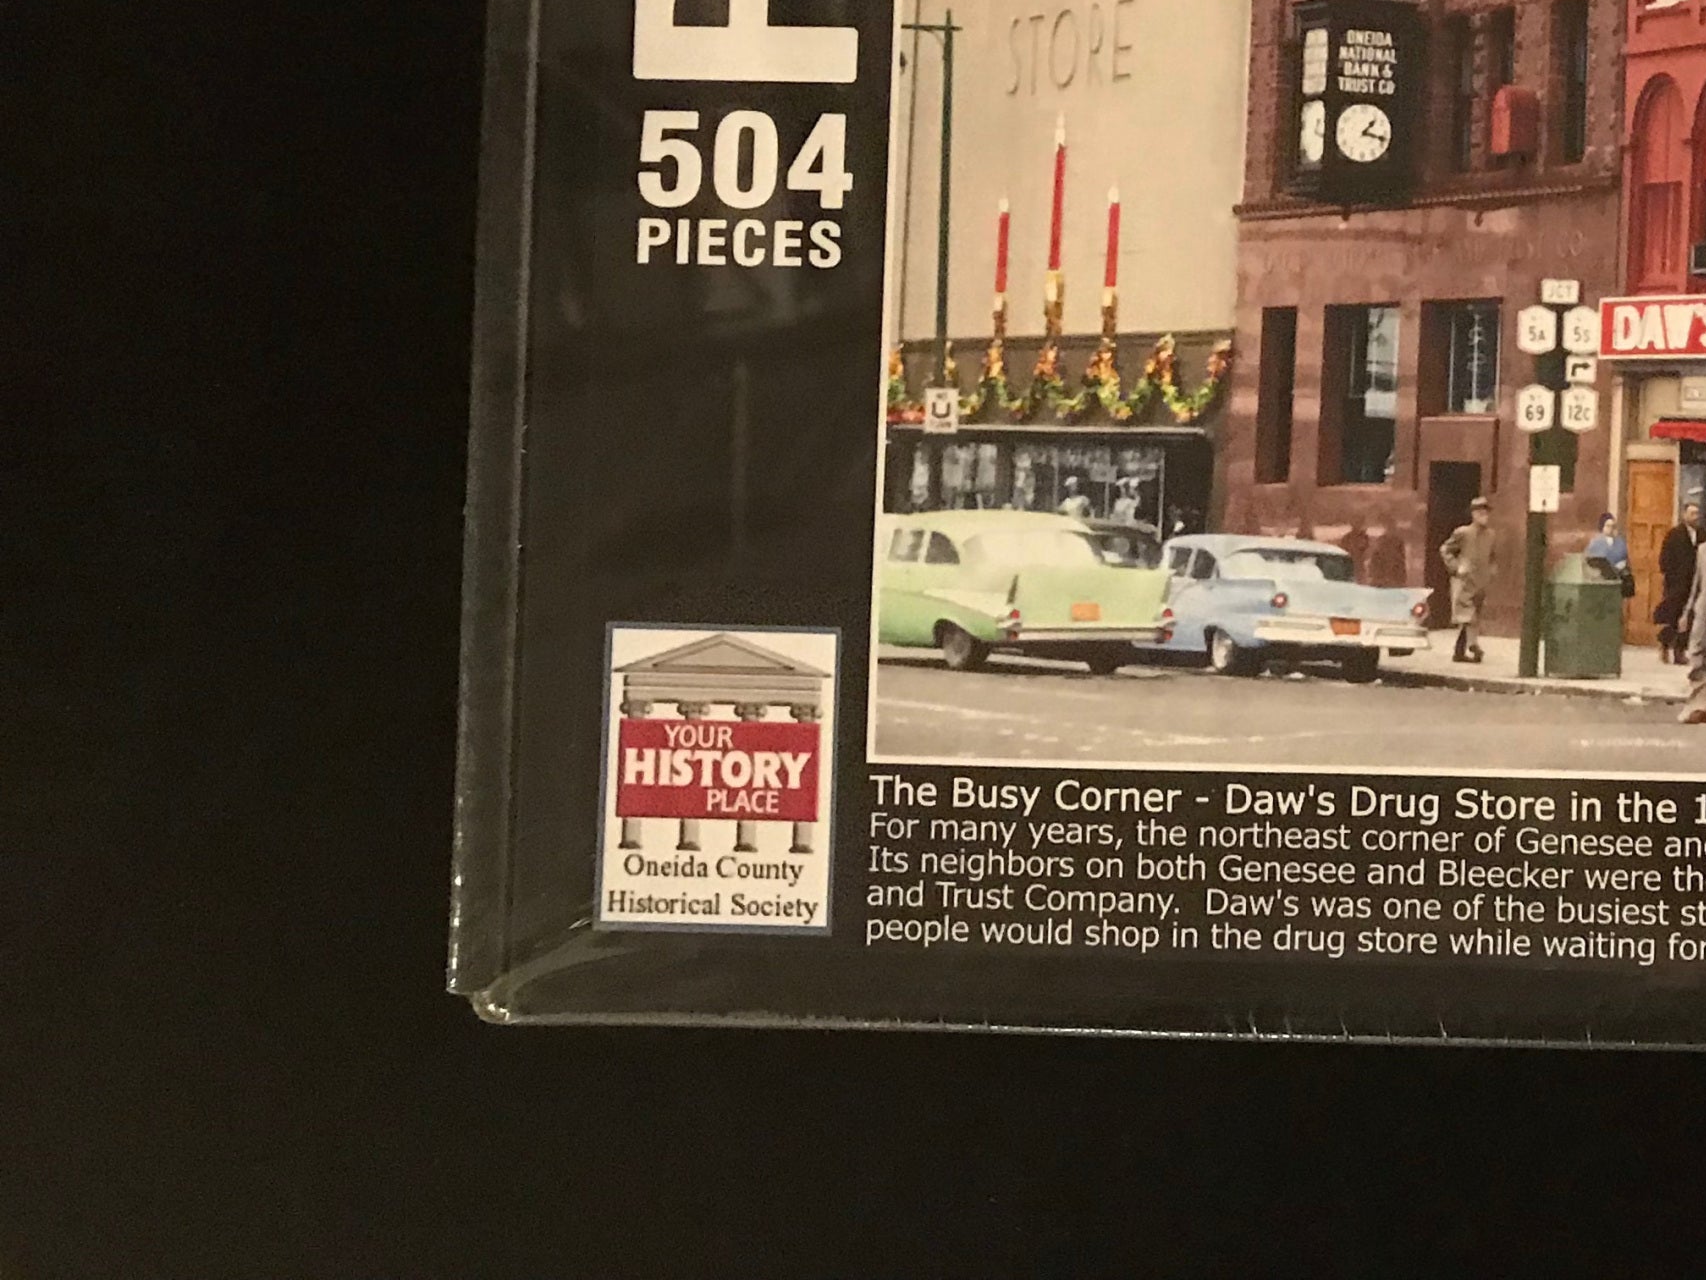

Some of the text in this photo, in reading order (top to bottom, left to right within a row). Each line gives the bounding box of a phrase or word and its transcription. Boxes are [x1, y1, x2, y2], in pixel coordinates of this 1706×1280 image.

[1339, 46, 1398, 64] NATIONAL
[1344, 61, 1380, 77] BANK
[1337, 76, 1376, 94] TRUST
[638, 110, 854, 209] 504
[637, 217, 842, 268] PIECES
[1528, 325, 1546, 342] 5A
[1525, 404, 1545, 422] 69
[664, 724, 734, 750] YOUR
[623, 747, 812, 789] HISTORY
[706, 789, 779, 814] PLACE
[869, 774, 938, 807] The
[952, 777, 1041, 817] Busy
[1054, 779, 1183, 813] Corner
[1226, 783, 1335, 816] Daw's
[1351, 785, 1440, 826] Drug
[1454, 787, 1556, 822] Store
[1570, 790, 1602, 822] in
[1616, 791, 1677, 824] the
[870, 812, 920, 840] For
[930, 819, 1017, 849] many
[1028, 822, 1123, 851] years,
[1136, 818, 1187, 847] the
[1199, 820, 1351, 850] northeast
[1361, 829, 1465, 852] corner
[1474, 825, 1507, 854] of
[1515, 826, 1653, 857] Genesee
[623, 852, 804, 888] Oneida County
[868, 845, 909, 873] Its
[921, 848, 1075, 882] neighbors
[1086, 857, 1124, 879] on
[1137, 852, 1206, 881] both
[1218, 854, 1356, 884] Genesee
[1367, 857, 1425, 886] and
[1438, 858, 1574, 889] Bleecker
[1584, 869, 1662, 892] were
[606, 889, 819, 925] Historical Society
[866, 879, 924, 907] and
[935, 880, 1015, 910] Trust
[1024, 883, 1180, 921] Company.
[1206, 888, 1299, 917] Daw's
[1311, 896, 1372, 919] was
[1383, 897, 1442, 920] one
[1453, 893, 1486, 921] of
[1493, 893, 1545, 923] the
[1557, 895, 1670, 926] busiest
[866, 914, 970, 948] people
[981, 917, 1073, 946] would
[1084, 918, 1160, 954] shop
[1172, 919, 1198, 949] in
[1210, 921, 1262, 950] the
[1273, 923, 1345, 959] drug
[1357, 926, 1438, 954] store
[1449, 927, 1531, 957] while
[1543, 932, 1655, 966] waiting
